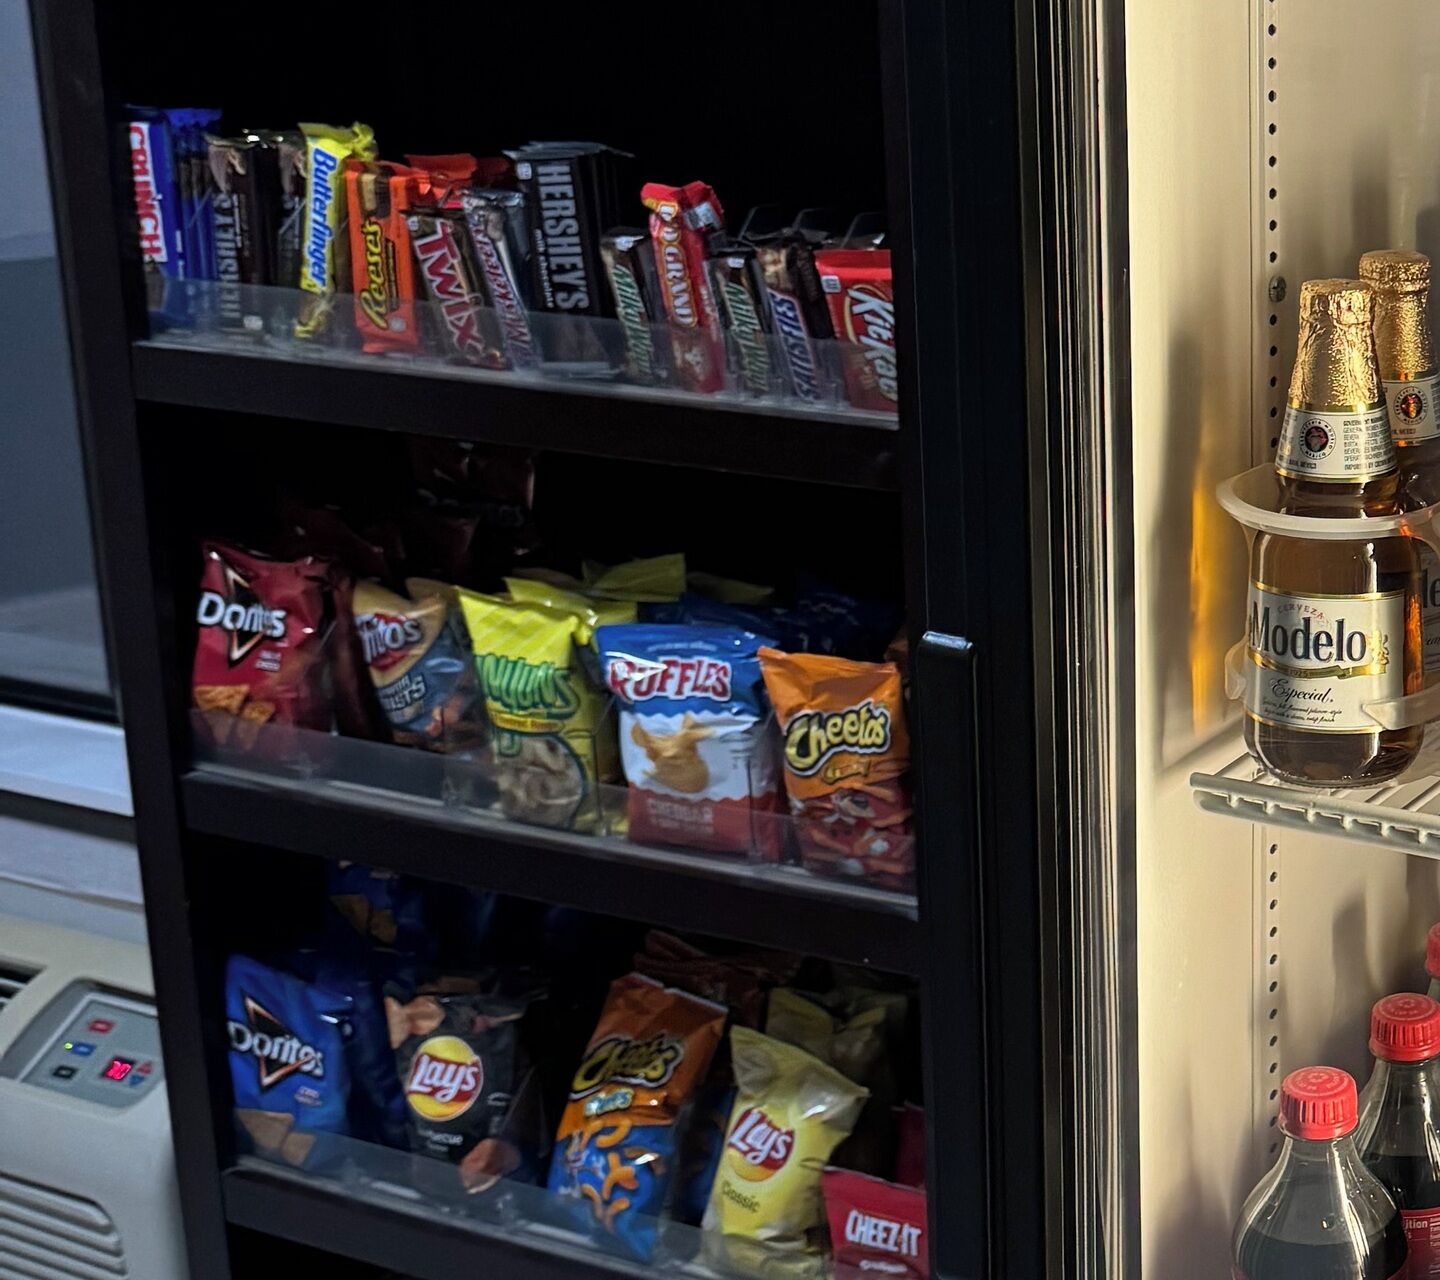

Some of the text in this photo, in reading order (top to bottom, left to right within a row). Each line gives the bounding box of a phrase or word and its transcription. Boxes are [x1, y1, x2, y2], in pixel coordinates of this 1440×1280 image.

[129, 123, 168, 264] CRUNCH
[306, 147, 338, 288] Butterfinger
[537, 163, 590, 310] HERSHEY'S
[662, 245, 699, 327] GRAND
[724, 283, 758, 341] Milky
[197, 592, 287, 639] Doritos
[1250, 600, 1367, 663] Modelo
[1276, 599, 1325, 619] CERVEZA
[607, 656, 732, 705] RUFFLES
[228, 1020, 324, 1077] Doritos
